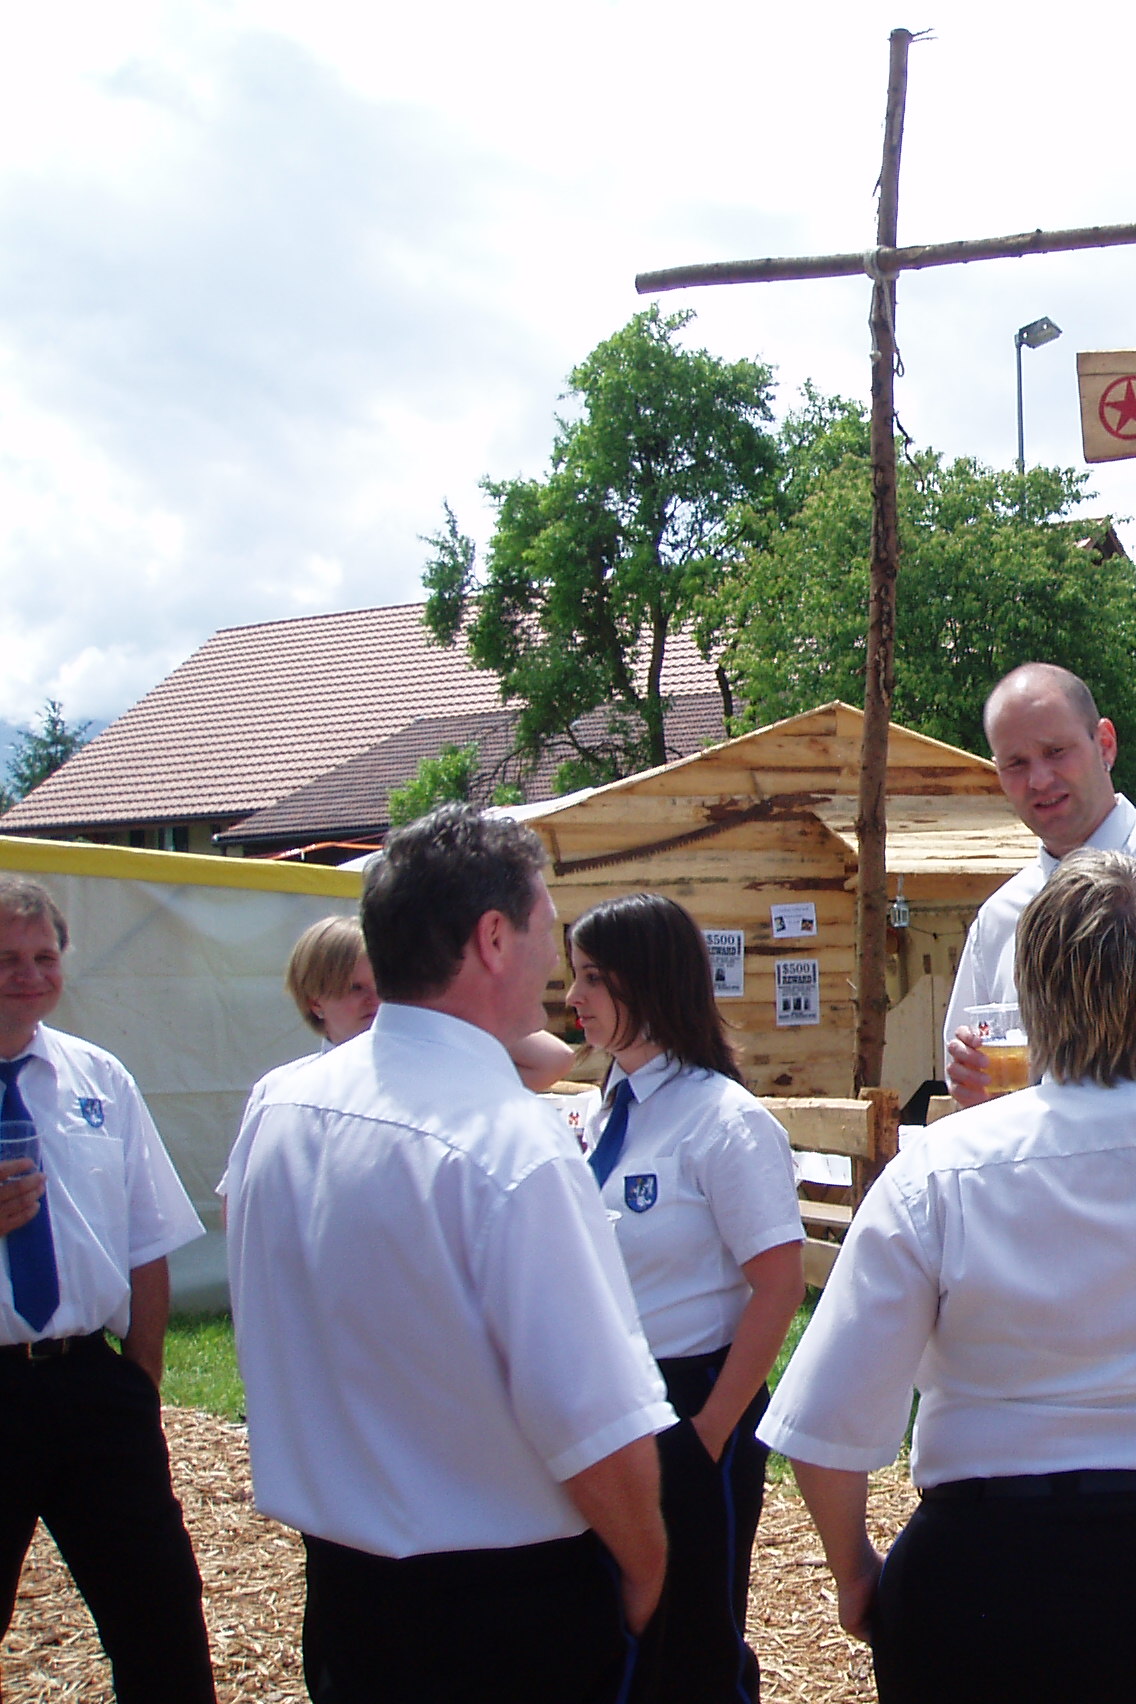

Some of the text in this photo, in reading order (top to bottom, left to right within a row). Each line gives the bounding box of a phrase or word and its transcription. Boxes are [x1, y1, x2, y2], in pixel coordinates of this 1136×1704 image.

[706, 934, 735, 945] $500
[782, 963, 810, 974] $500
[782, 975, 812, 985] REWARD
